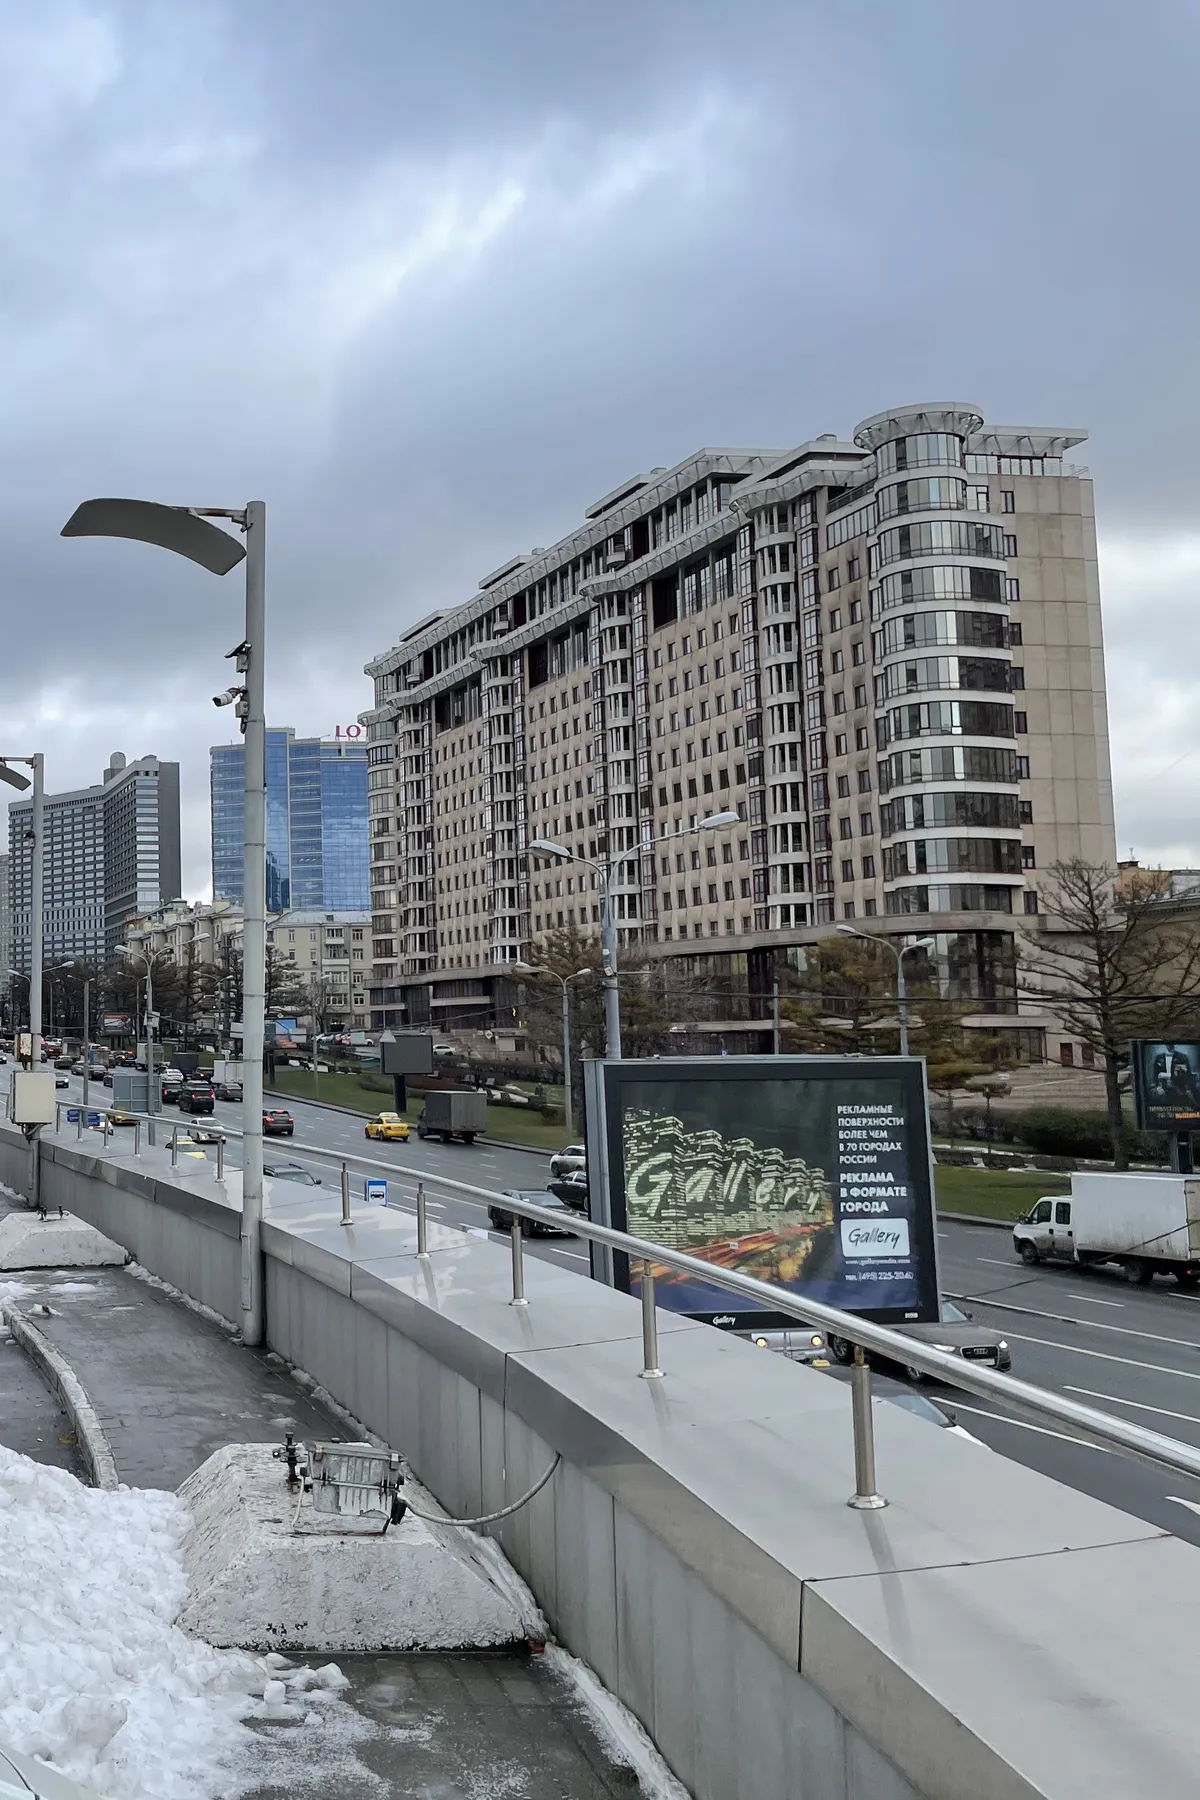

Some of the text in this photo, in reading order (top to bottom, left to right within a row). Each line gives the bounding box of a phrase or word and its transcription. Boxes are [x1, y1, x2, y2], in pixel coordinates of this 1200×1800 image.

[336, 725, 369, 738] LO
[837, 1105, 893, 1114] РЕКЛАМНЫЕ
[838, 1117, 904, 1127] ПОВЕРХНОСТИ
[838, 1129, 888, 1139] БОЛЕЕ ЧЕМ
[839, 1142, 902, 1152] В 70 ГОРОДАХ
[839, 1154, 878, 1164] РОССИИ
[840, 1172, 895, 1183] РЕКЛАМА
[627, 1152, 821, 1217] Gallery
[840, 1186, 908, 1198] В ФОРМАТЕ
[840, 1201, 890, 1213] ГОРОДА
[848, 1227, 901, 1250] Gallery
